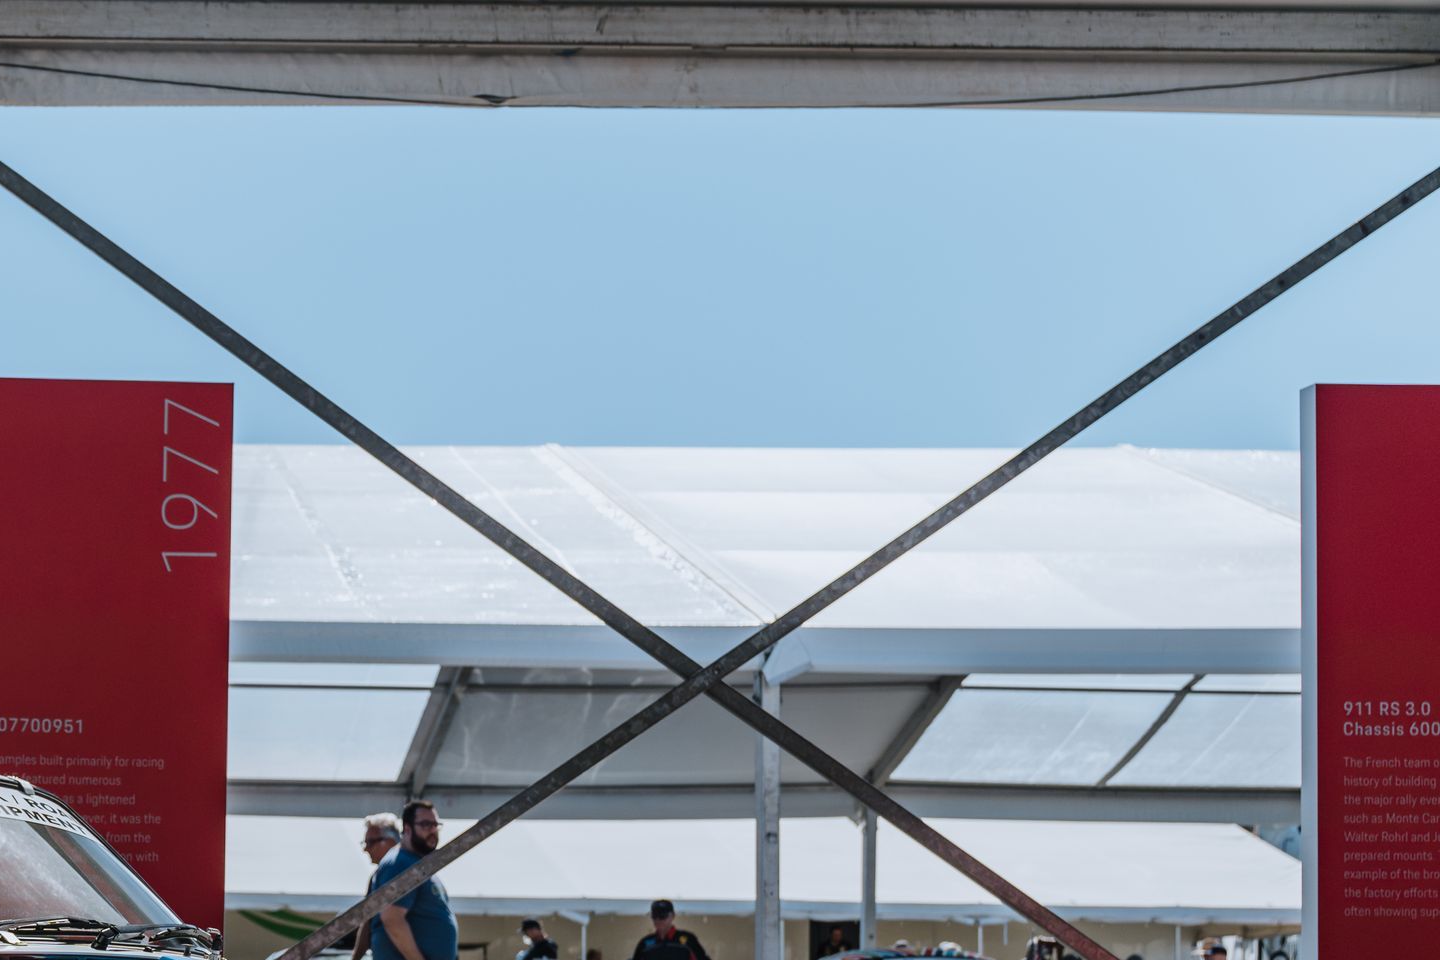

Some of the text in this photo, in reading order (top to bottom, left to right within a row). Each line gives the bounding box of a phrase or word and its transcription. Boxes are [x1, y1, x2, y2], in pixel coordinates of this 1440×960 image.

[161, 398, 221, 573] 1977
[1343, 701, 1431, 717] 911 RS 3.0
[1343, 721, 1405, 737] Chassis
[39, 755, 64, 767] built
[66, 756, 111, 770] primarily
[114, 756, 130, 768] for
[131, 758, 165, 771] racing
[1344, 756, 1364, 769] The
[1366, 756, 1401, 769] French
[1403, 758, 1431, 769] team
[69, 775, 122, 787] numerous
[1343, 775, 1437, 790] history of building
[86, 793, 137, 808] lightened
[1344, 794, 1362, 806] the
[1363, 794, 1393, 809] major
[1395, 794, 1418, 809] rally
[109, 812, 119, 825] it
[120, 814, 142, 825] was
[144, 812, 162, 825] the
[1343, 813, 1370, 825] such
[1371, 814, 1384, 825] as
[1386, 812, 1420, 825] Monte
[133, 831, 152, 844] the
[1344, 831, 1380, 843] Walter
[1410, 831, 1431, 843] and
[135, 850, 160, 863] with
[1343, 850, 1391, 864] prepared
[1343, 868, 1389, 882] example
[1390, 867, 1401, 880] of
[1402, 867, 1421, 880] the
[1344, 886, 1439, 902] the factory efforts
[1344, 905, 1371, 917] often
[1372, 905, 1417, 920] showing
